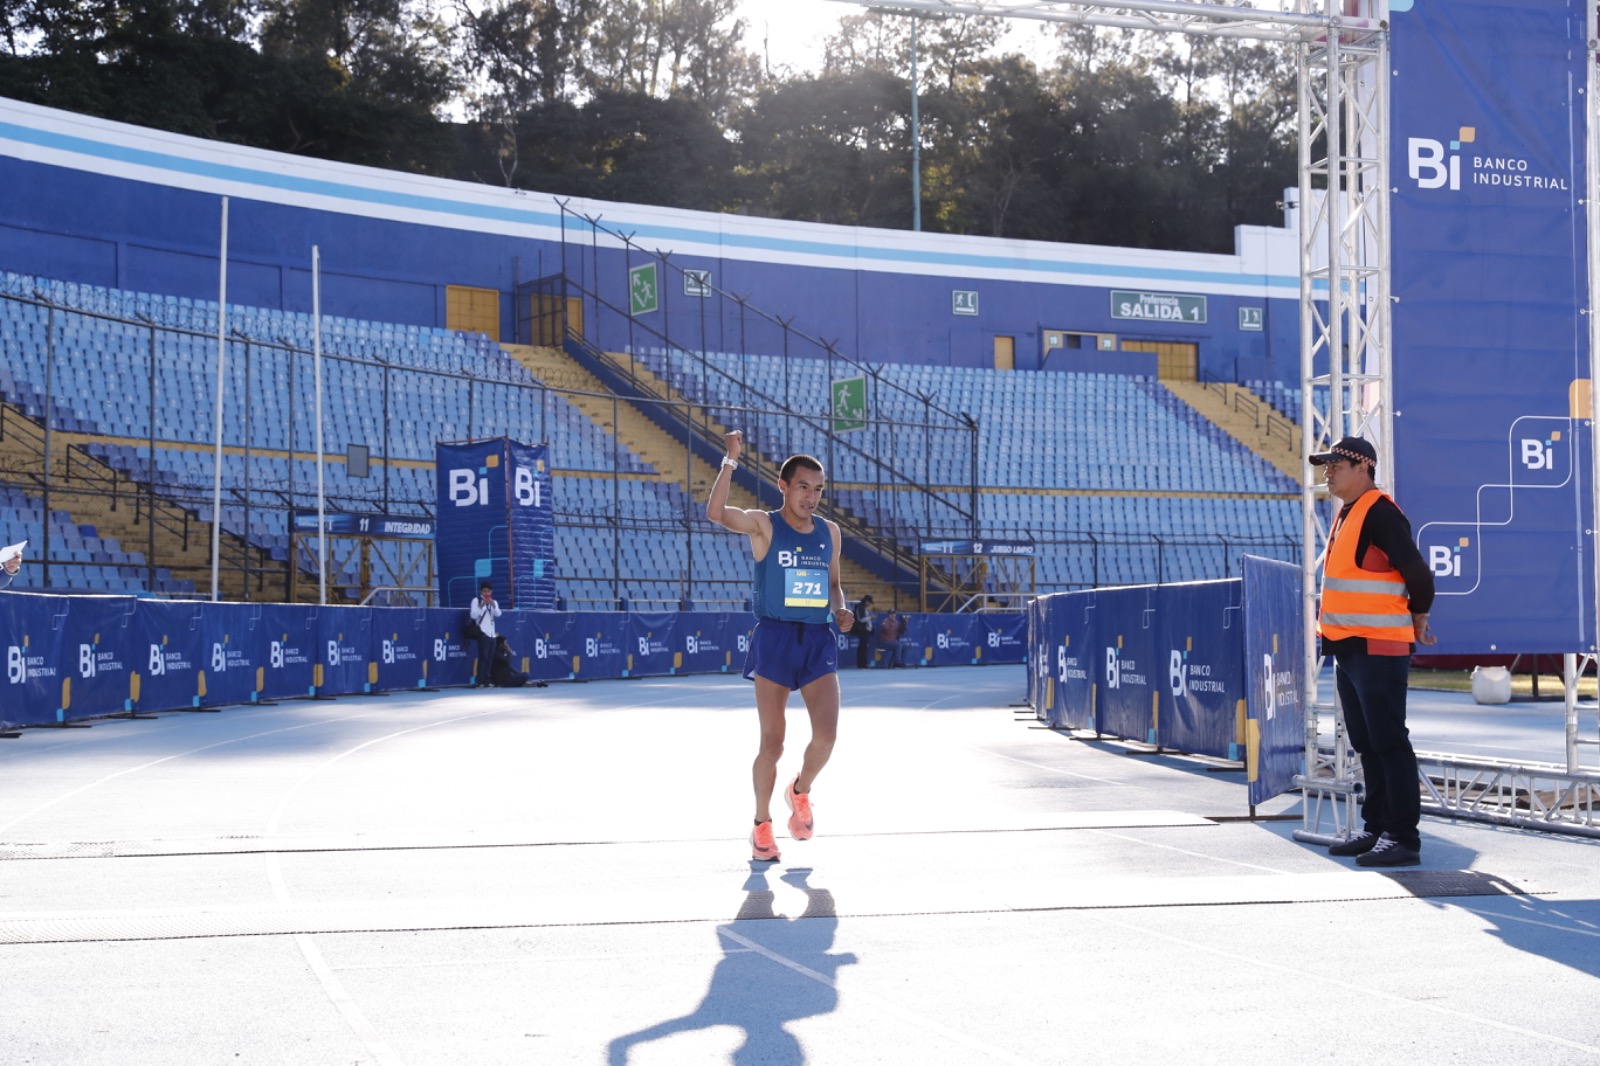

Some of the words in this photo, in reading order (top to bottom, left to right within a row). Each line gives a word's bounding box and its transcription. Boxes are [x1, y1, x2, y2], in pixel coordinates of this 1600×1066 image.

[1408, 137, 1461, 190] Bi
[1473, 156, 1528, 171] BANCO
[1473, 172, 1568, 190] INDUSTRIAL
[1140, 294, 1179, 306] Preferencia
[1120, 302, 1184, 320] SALIDA
[1190, 306, 1200, 321] 1
[1521, 438, 1553, 470] Bi
[449, 466, 489, 507] Bi
[515, 466, 541, 508] Bi
[359, 518, 370, 532] 11
[384, 521, 431, 535] INTEGRIDAD
[973, 542, 983, 554] 12
[990, 545, 1012, 554] JUEGO
[1013, 545, 1034, 554] LIMPIO
[778, 549, 798, 568] Bi
[1429, 544, 1461, 577] Bi
[792, 581, 822, 596] 271
[434, 638, 447, 661] Bi
[535, 638, 548, 659] Bi
[586, 637, 599, 657] Bi
[638, 636, 650, 656] Bi
[686, 635, 699, 654] Bi
[937, 633, 951, 649] Bi
[987, 632, 1000, 648] Bi
[27, 656, 45, 666] BANCO
[79, 643, 97, 679] Bi
[97, 652, 114, 661] BANCO
[148, 643, 166, 676] Bi
[211, 642, 227, 672] Bi
[270, 640, 285, 669] Bi
[327, 640, 341, 666] Bi
[382, 639, 395, 664] Bi
[7, 645, 27, 685] Bi
[27, 667, 57, 678] INDUSTRIAL
[1106, 646, 1121, 690] Bi
[1121, 660, 1136, 671] BANCO
[1169, 649, 1188, 698] Bi
[1190, 664, 1211, 676] BANCO
[1121, 674, 1147, 686] INDUSTRIAL
[1189, 680, 1225, 693] INDUSTRIAL
